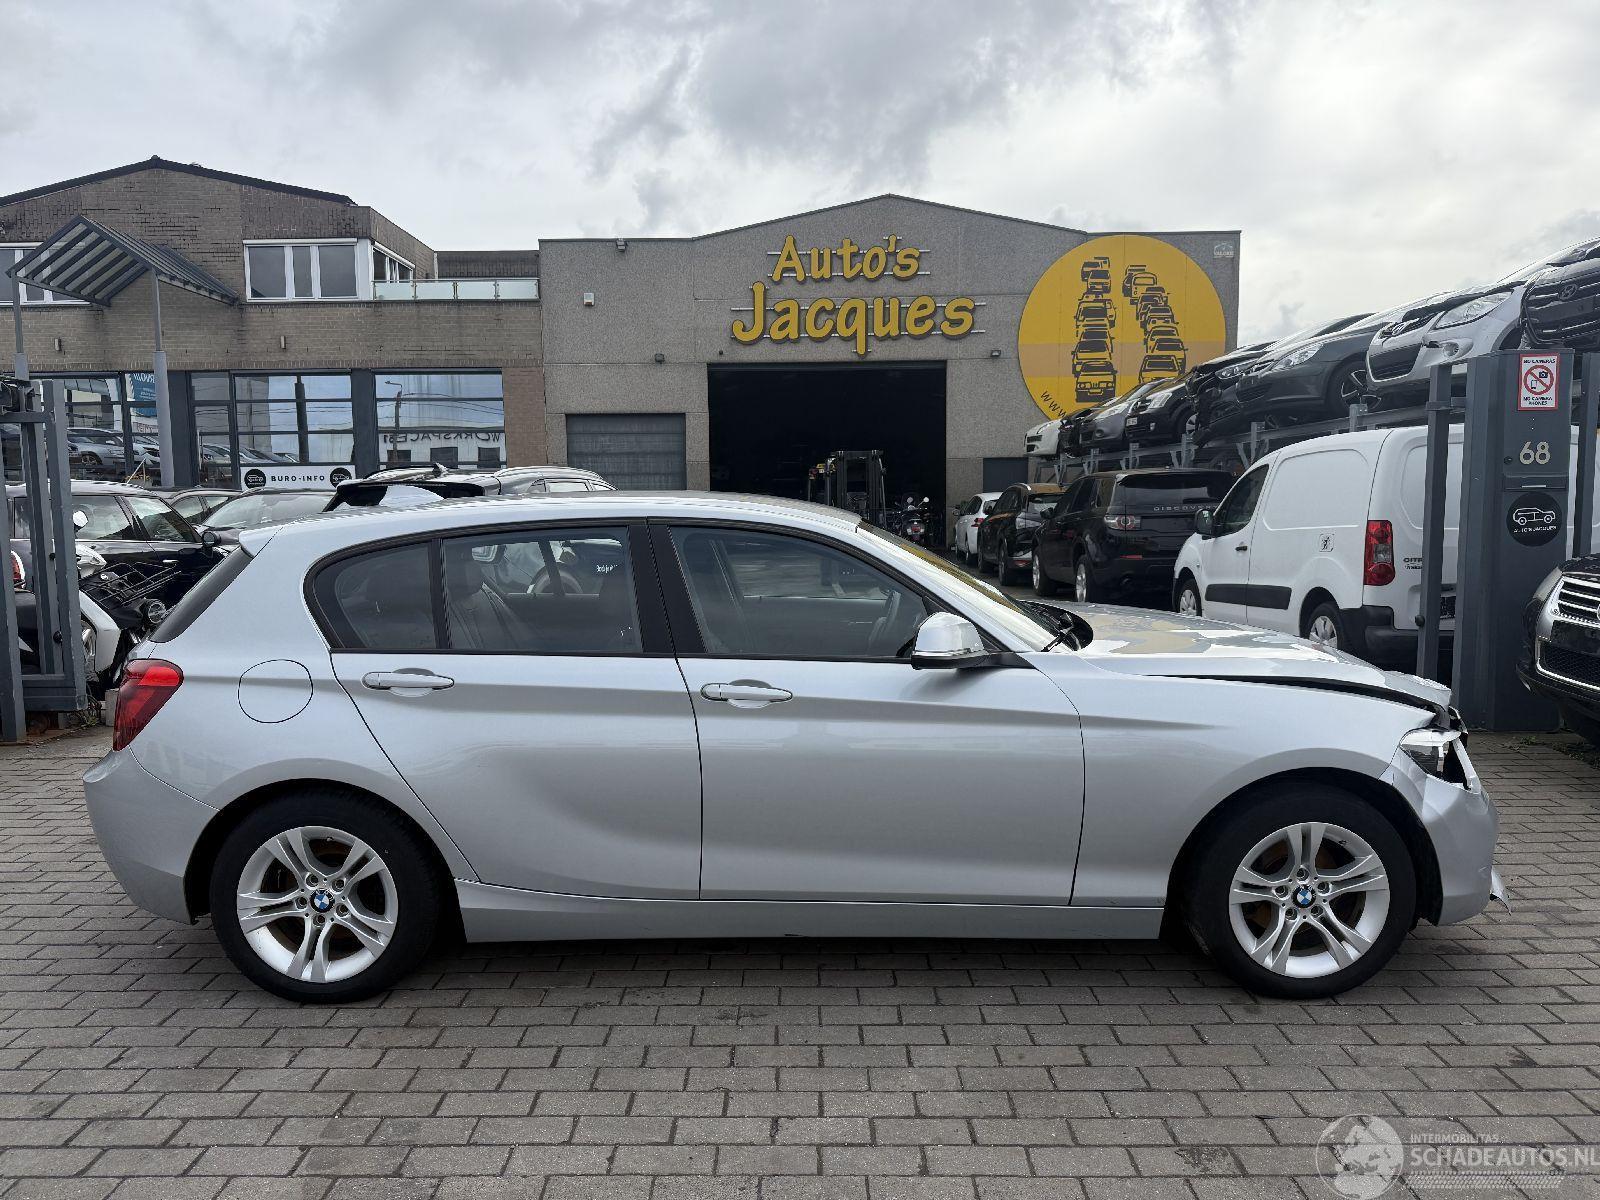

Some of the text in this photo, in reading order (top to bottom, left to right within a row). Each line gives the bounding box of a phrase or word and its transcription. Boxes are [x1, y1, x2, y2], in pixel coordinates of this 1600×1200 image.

[771, 233, 921, 283] Auto's
[731, 280, 977, 357] Jacques
[1520, 441, 1551, 465] 68
